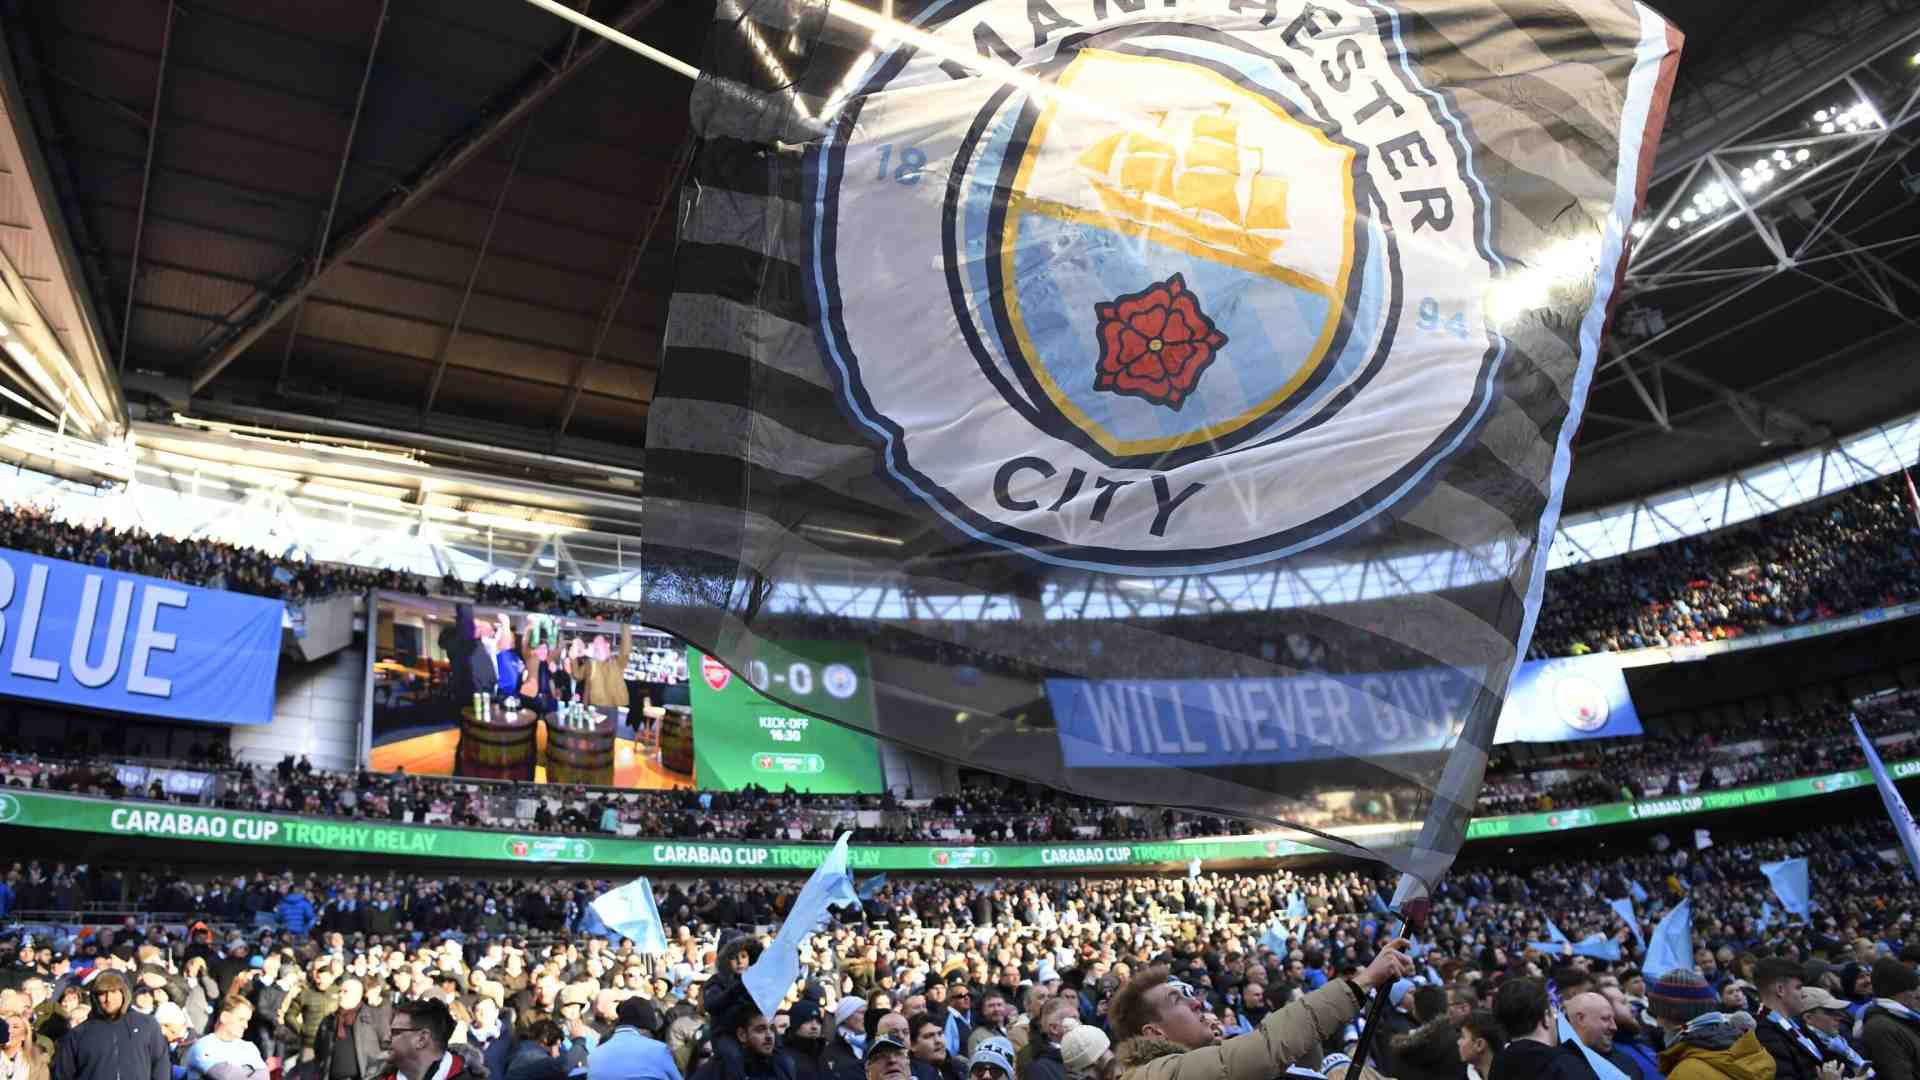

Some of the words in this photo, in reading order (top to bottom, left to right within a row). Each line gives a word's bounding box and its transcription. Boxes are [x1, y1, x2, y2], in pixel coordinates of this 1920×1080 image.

[940, 0, 1455, 234] MAESTER
[877, 143, 928, 185] 18
[1417, 297, 1472, 341] 94
[993, 456, 1205, 537] CITY
[759, 716, 809, 729] KICK-OFF
[769, 729, 801, 741] 16:30
[1082, 682, 1206, 753] WILL
[1209, 677, 1363, 751] NEVER
[1682, 797, 1703, 811] CUP
[111, 808, 227, 837] CARABAO
[232, 818, 279, 841] CUP
[283, 821, 369, 848] TROPHY
[373, 830, 437, 852] RELAY
[653, 845, 733, 863] CARABAO
[736, 846, 767, 865] CUP
[847, 850, 881, 866] ELAY
[1041, 848, 1104, 864] CARABAO
[1105, 846, 1131, 862] CUP
